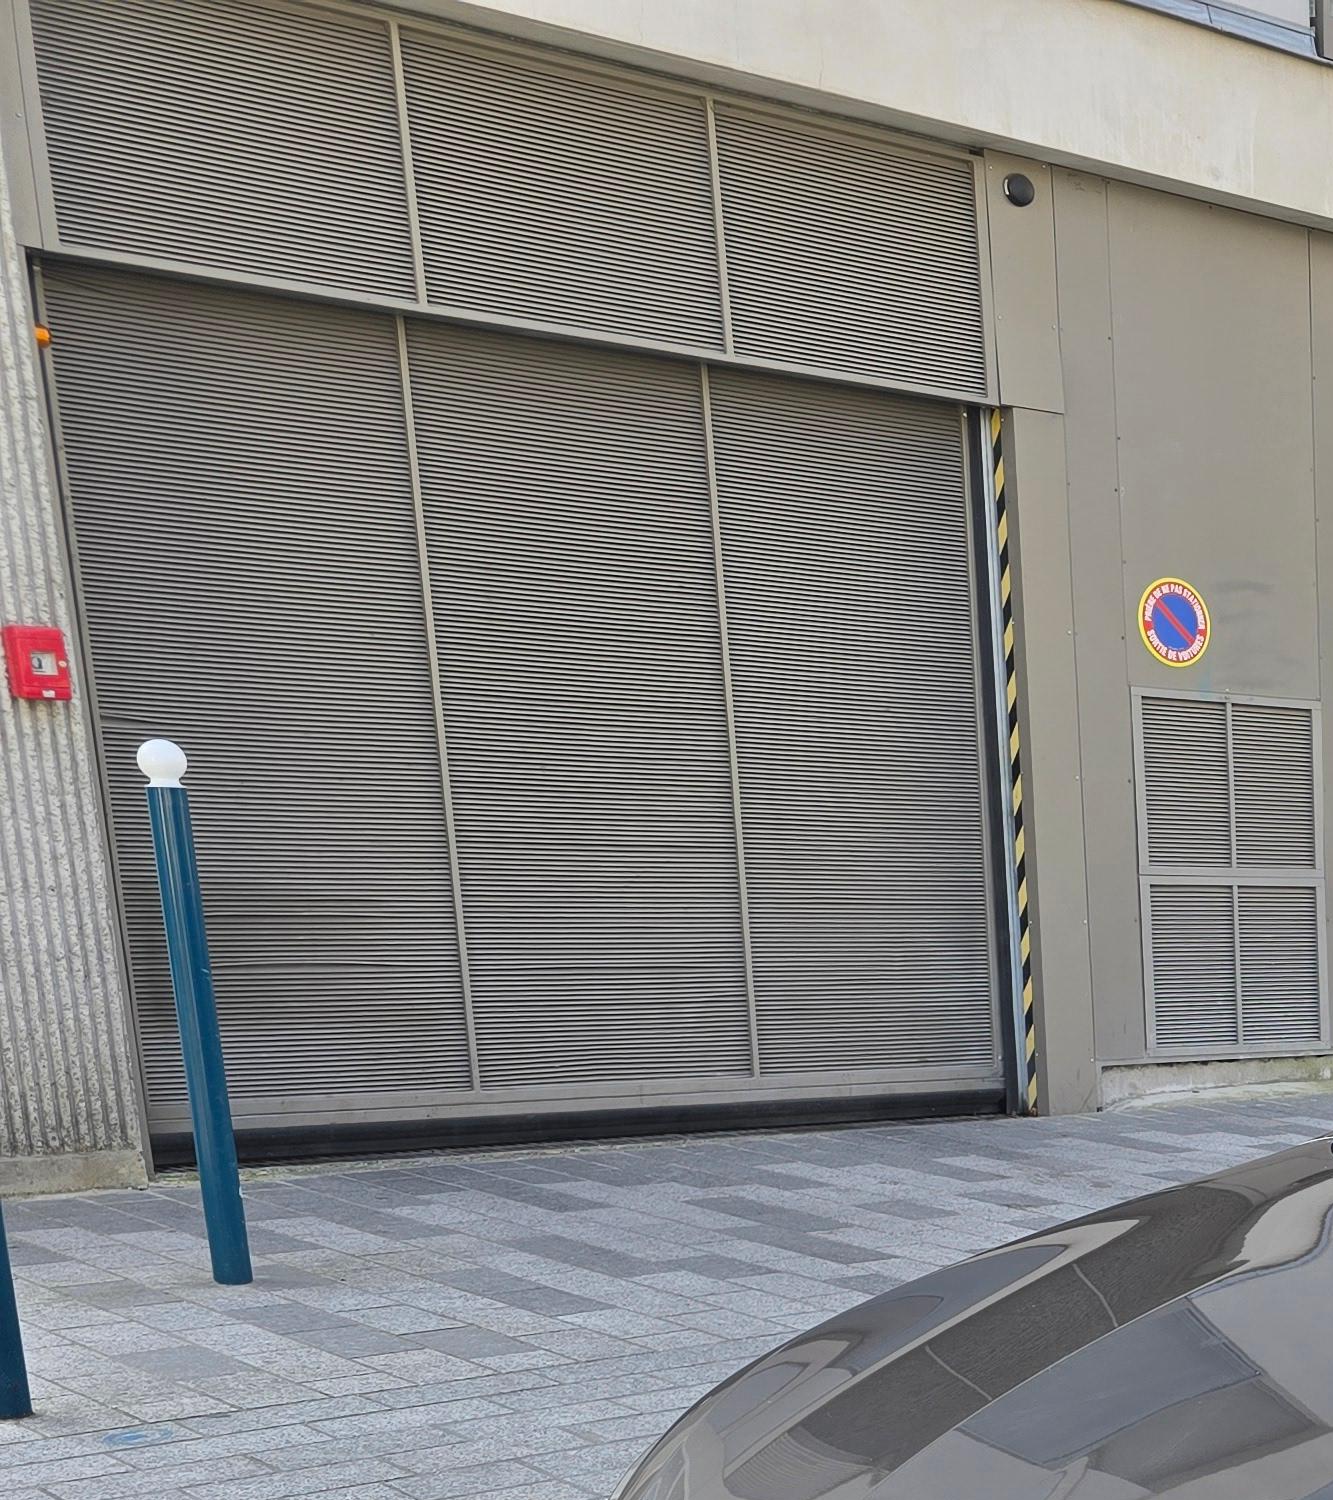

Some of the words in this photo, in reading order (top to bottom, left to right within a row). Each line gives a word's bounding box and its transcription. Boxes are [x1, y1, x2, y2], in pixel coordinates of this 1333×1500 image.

[1170, 584, 1183, 595] PAS
[1147, 629, 1167, 657] SORTIE
[1167, 649, 1178, 661] DE
[1178, 635, 1204, 661] VOITURES
